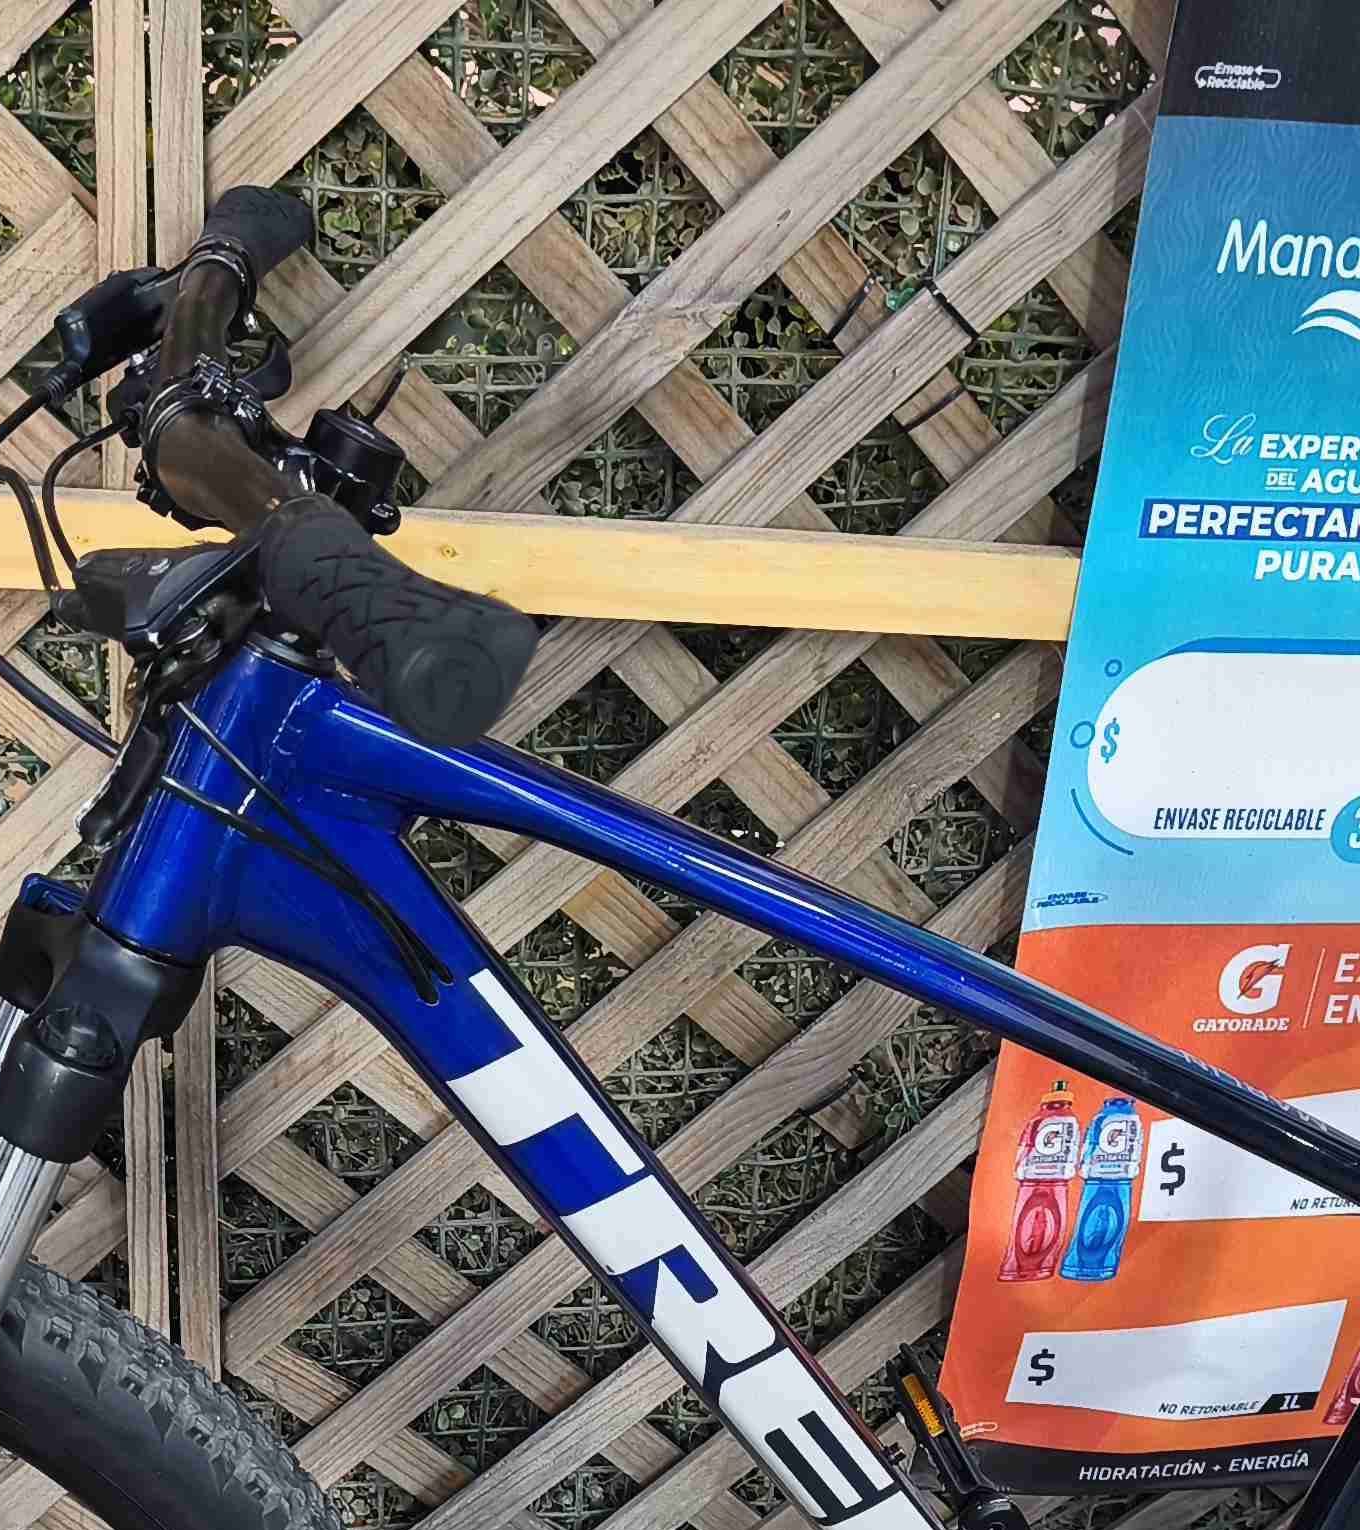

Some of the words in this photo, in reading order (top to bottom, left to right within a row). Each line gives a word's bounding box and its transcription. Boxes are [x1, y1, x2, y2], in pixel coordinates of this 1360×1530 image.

[1190, 413, 1257, 465] La
[1265, 470, 1297, 488] DEL
[1253, 549, 1360, 582] PURA
[1099, 717, 1121, 764] $
[1153, 807, 1222, 831] ENVASE
[1222, 808, 1327, 831] RECICLABLE
[1218, 943, 1293, 1015] G
[1192, 1017, 1290, 1033] GATORADE
[1158, 1142, 1187, 1197] $
[1289, 1198, 1309, 1210] NO
[1027, 1348, 1056, 1386] $
[1158, 1402, 1178, 1415] NO
[1179, 1400, 1260, 1416] RETORNABLE
[1279, 1394, 1302, 1411] 1L
[1078, 1458, 1206, 1481] HIDRATACIÓN
[1228, 1448, 1310, 1473] ENERGÍA
